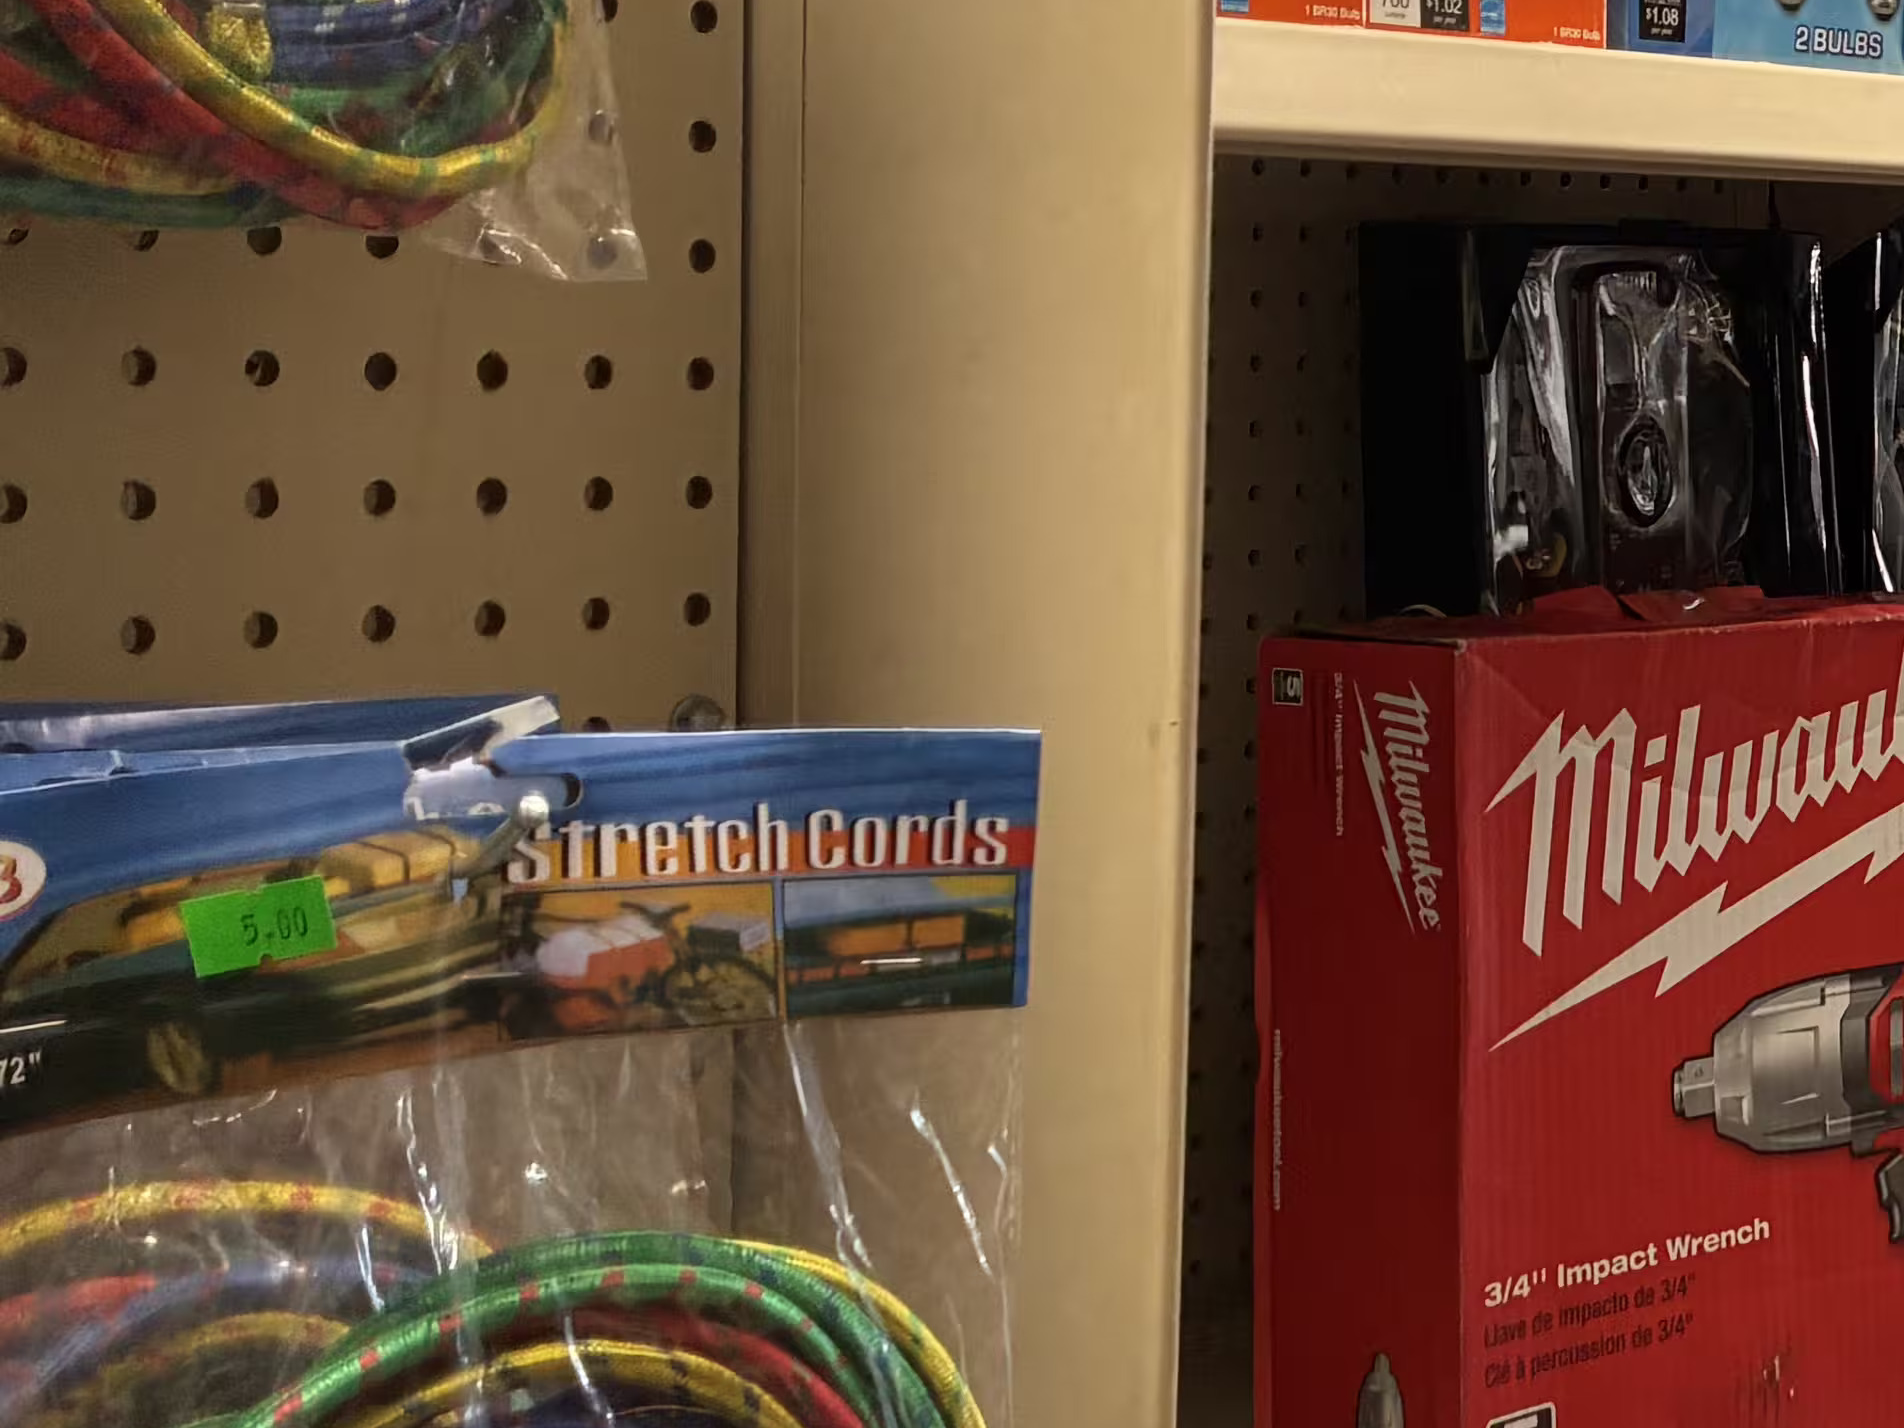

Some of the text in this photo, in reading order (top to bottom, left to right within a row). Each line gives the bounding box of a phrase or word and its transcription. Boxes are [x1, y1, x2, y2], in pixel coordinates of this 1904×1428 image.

[1645, 6, 1679, 26] $1.08
[1794, 25, 1883, 58] 2 BULBS
[1286, 676, 1301, 699] 5
[1333, 713, 1346, 837] Impact Wrench
[1373, 678, 1444, 933] Milwaukee
[506, 798, 1010, 885] Stretch Cords
[239, 905, 310, 948] 5.00
[1272, 1028, 1282, 1211] milwaukeetool.com
[1484, 1216, 1771, 1308] 3/4" Impact Wrench
[1484, 1273, 1697, 1349] Llave de impacto de 3/4"
[1515, 1356, 1527, 1380] à
[1530, 1331, 1626, 1380] percussion
[1631, 1324, 1654, 1350] de
[1657, 1313, 1695, 1345] 3/4"
